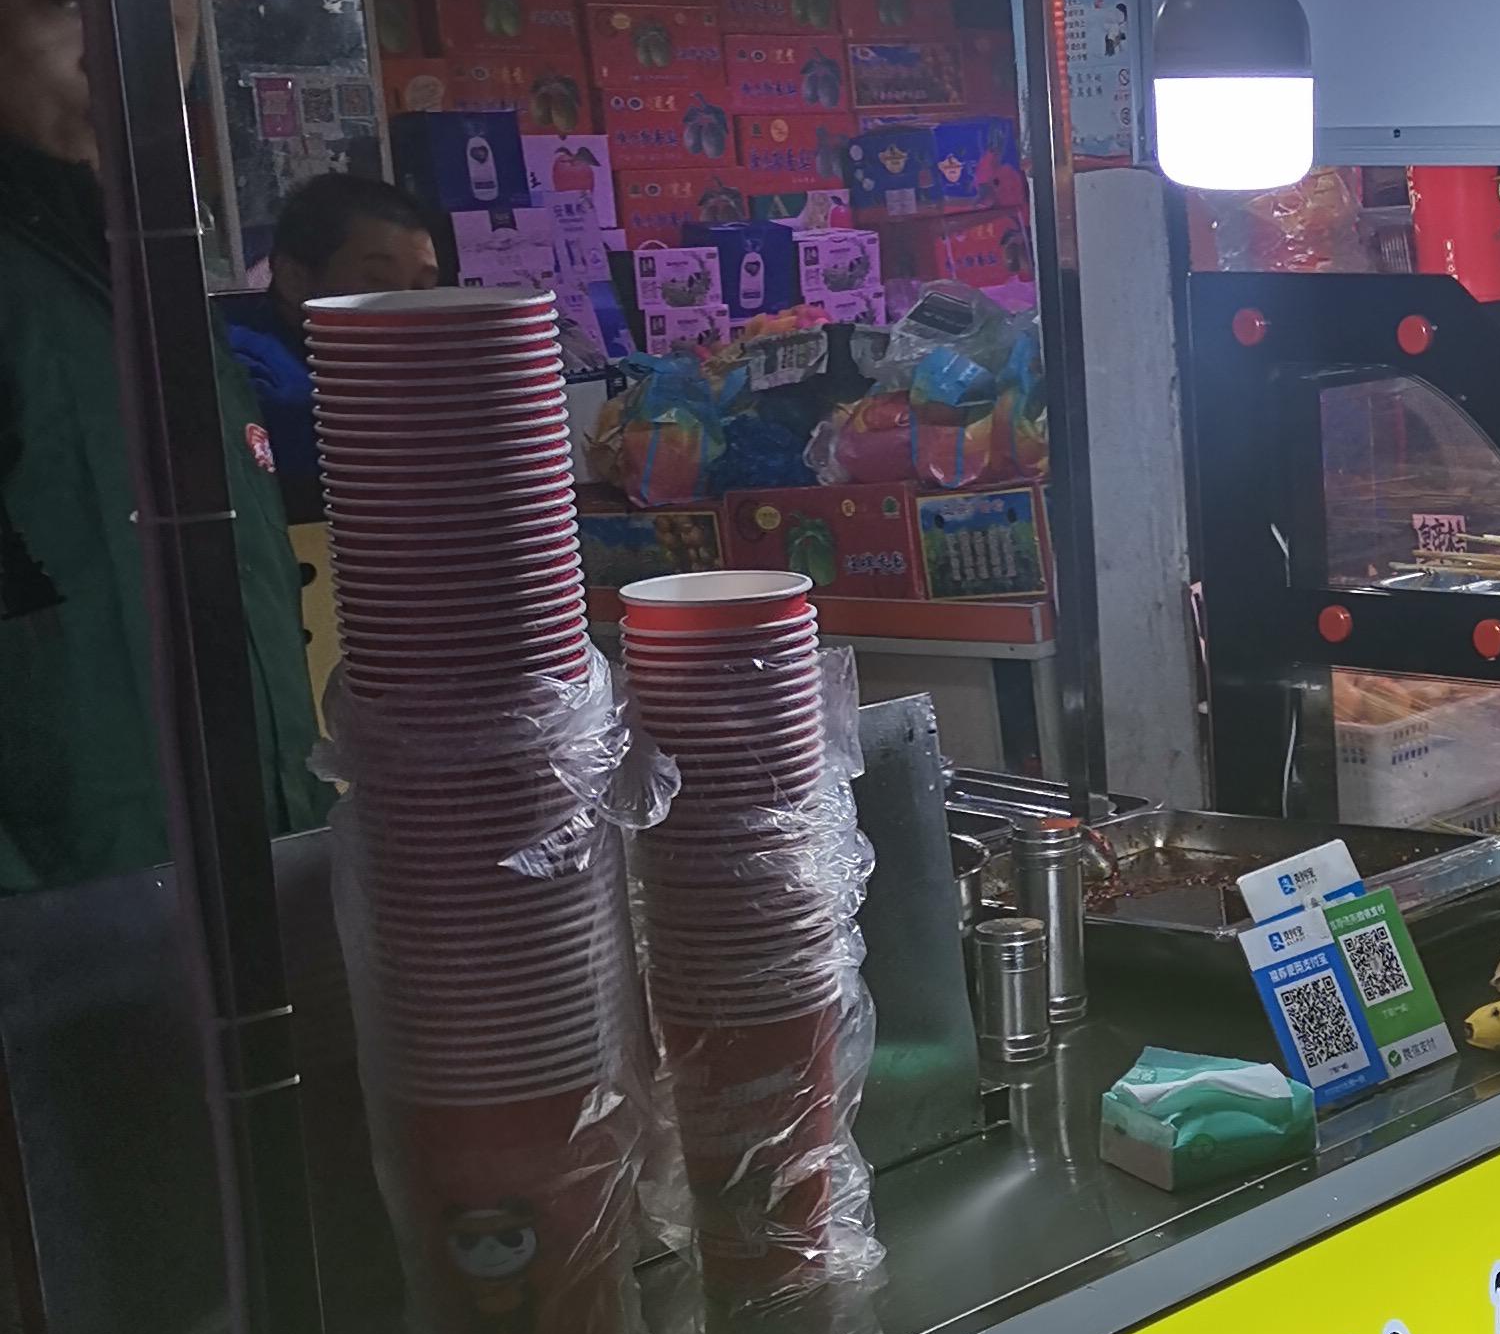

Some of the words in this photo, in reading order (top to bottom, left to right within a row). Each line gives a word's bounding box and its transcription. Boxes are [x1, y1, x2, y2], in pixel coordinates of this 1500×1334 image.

[1293, 867, 1316, 884] 支付宝
[1282, 925, 1305, 942] 支付宝
[1401, 1037, 1438, 1062] 微信支付
